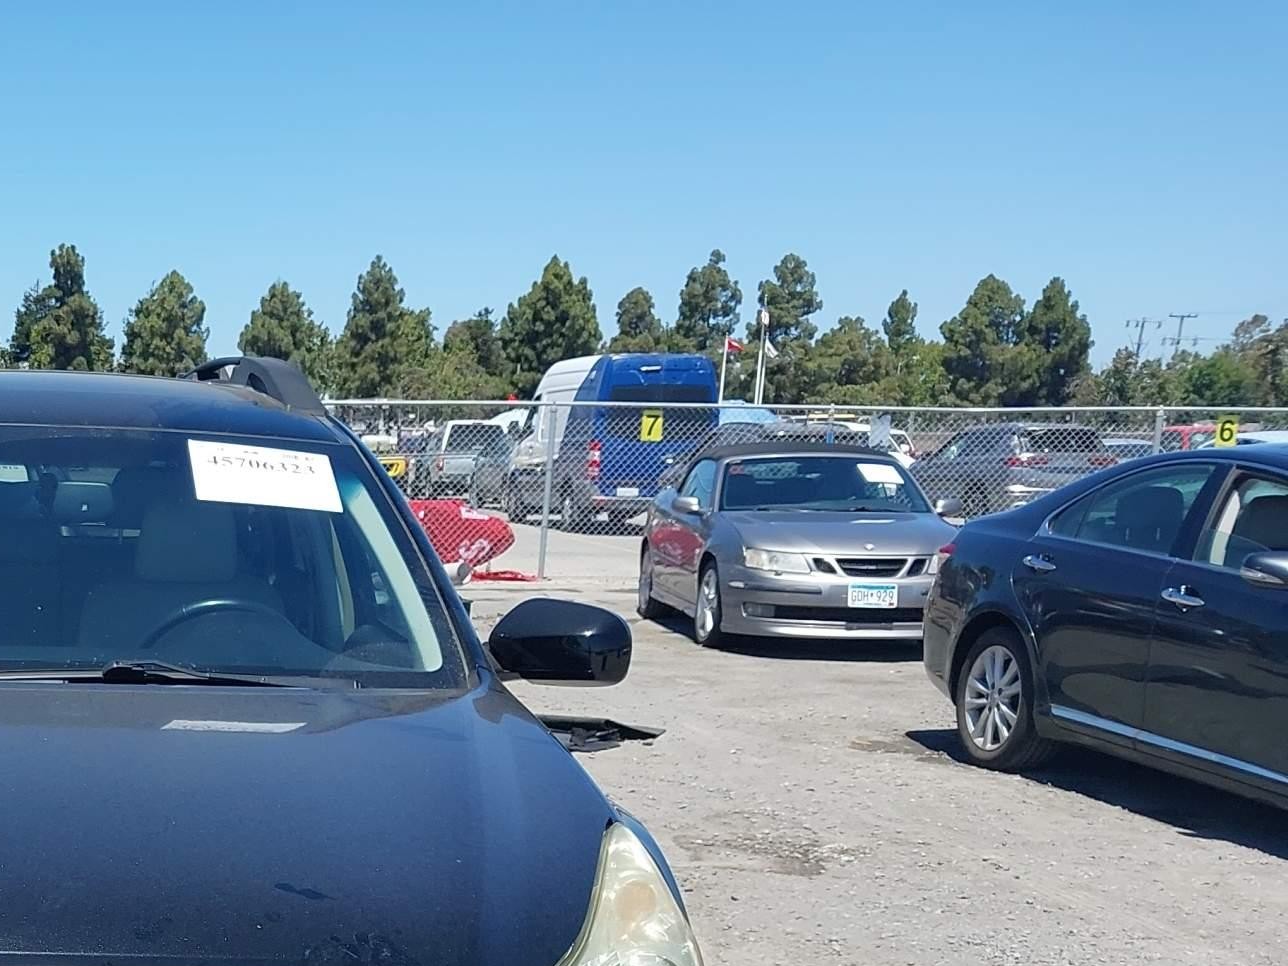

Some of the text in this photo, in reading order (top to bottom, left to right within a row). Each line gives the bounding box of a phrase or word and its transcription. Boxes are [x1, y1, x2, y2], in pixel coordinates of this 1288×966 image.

[646, 415, 660, 436] 7
[1220, 420, 1234, 442] 6
[207, 455, 317, 475] 45706323
